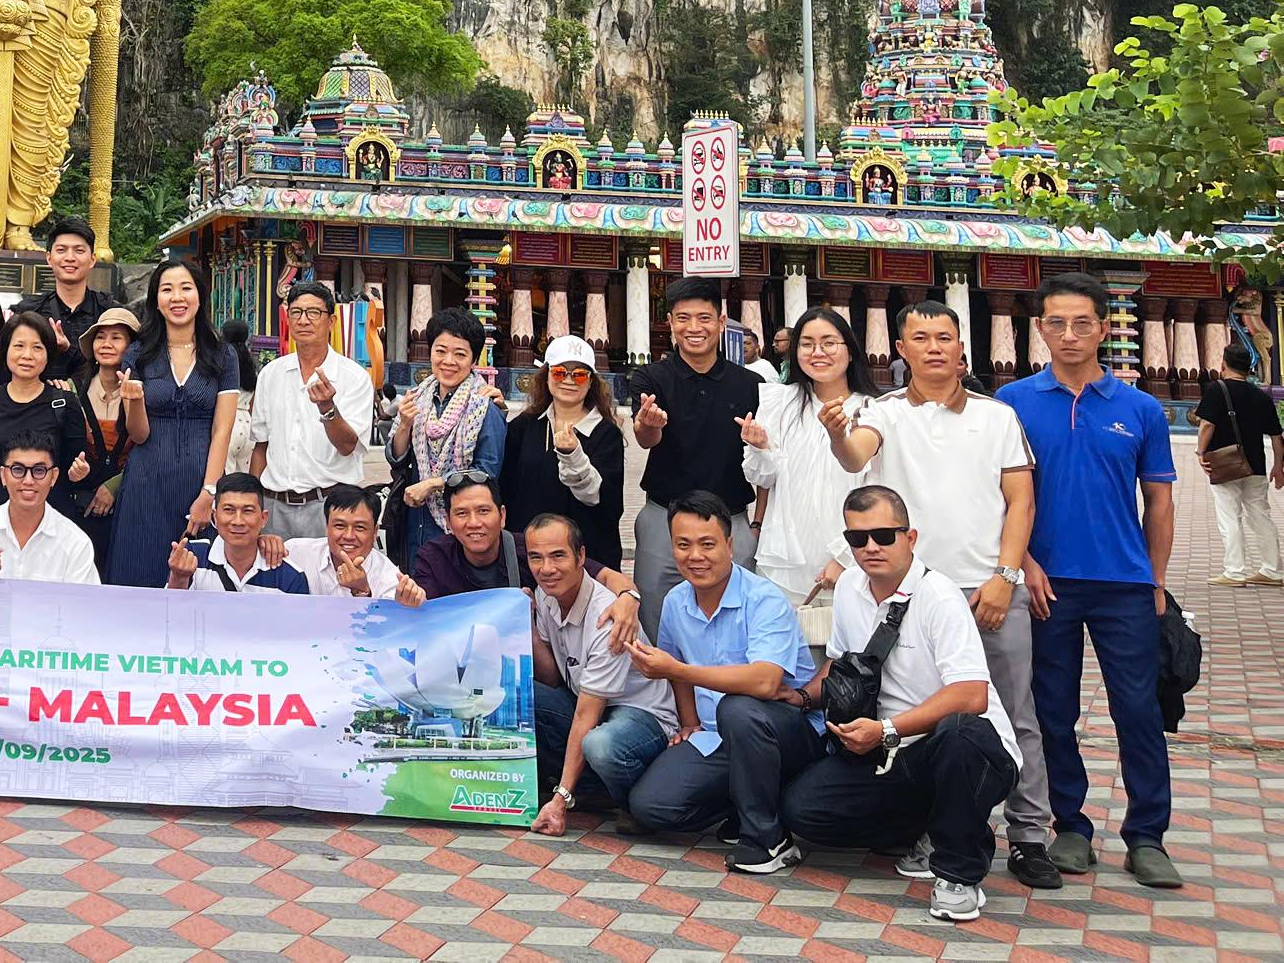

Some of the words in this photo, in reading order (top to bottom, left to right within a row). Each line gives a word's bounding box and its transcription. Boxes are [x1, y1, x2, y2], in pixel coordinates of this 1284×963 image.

[696, 217, 722, 241] NO
[688, 244, 730, 262] ENTRY
[118, 655, 243, 676] VIETNAM
[251, 660, 289, 678] TO
[28, 687, 318, 728] MALAYSIA
[450, 768, 510, 782] ORGANIZED
[512, 772, 525, 783] BY
